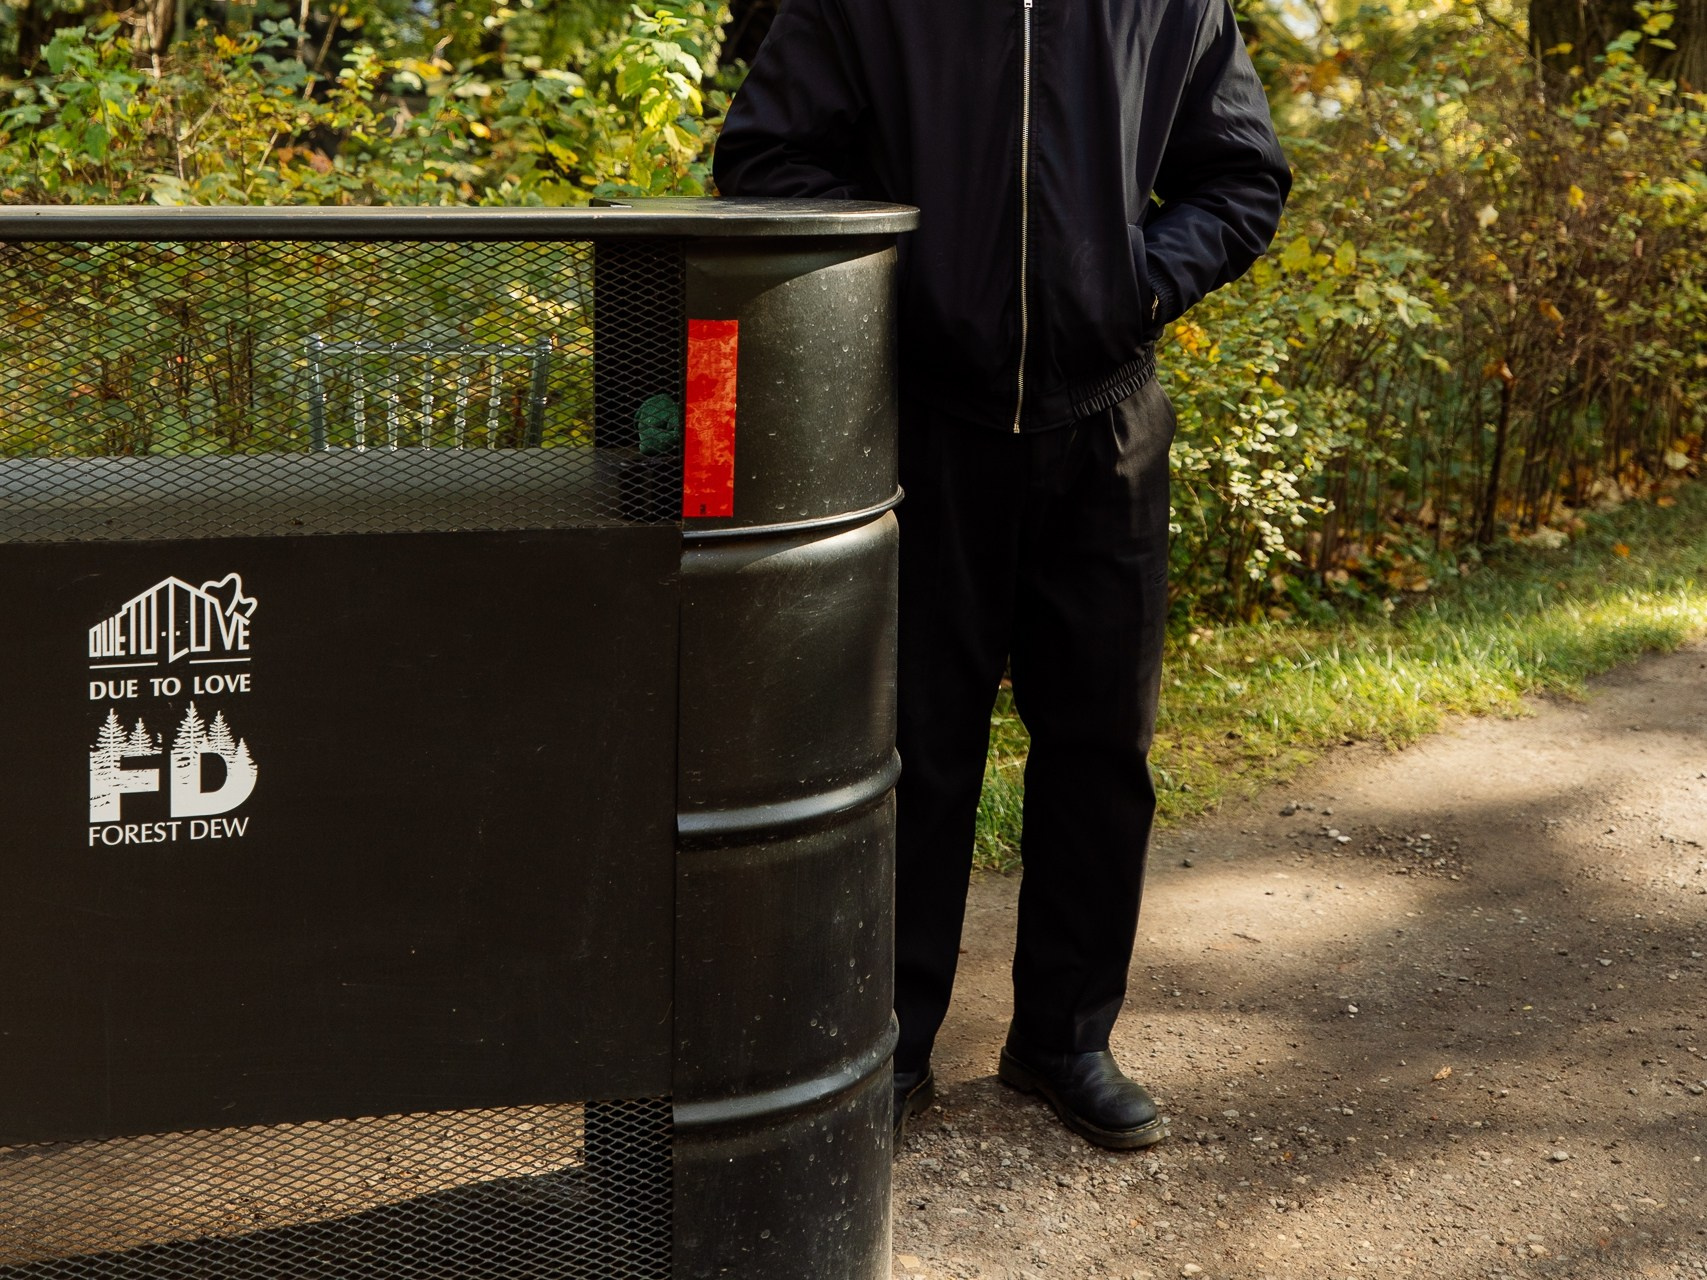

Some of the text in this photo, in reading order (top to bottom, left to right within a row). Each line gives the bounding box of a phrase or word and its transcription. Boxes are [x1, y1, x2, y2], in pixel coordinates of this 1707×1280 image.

[89, 673, 251, 700] DUE TO LOVE
[89, 736, 258, 823] FD
[88, 816, 249, 847] FOREST DEW
